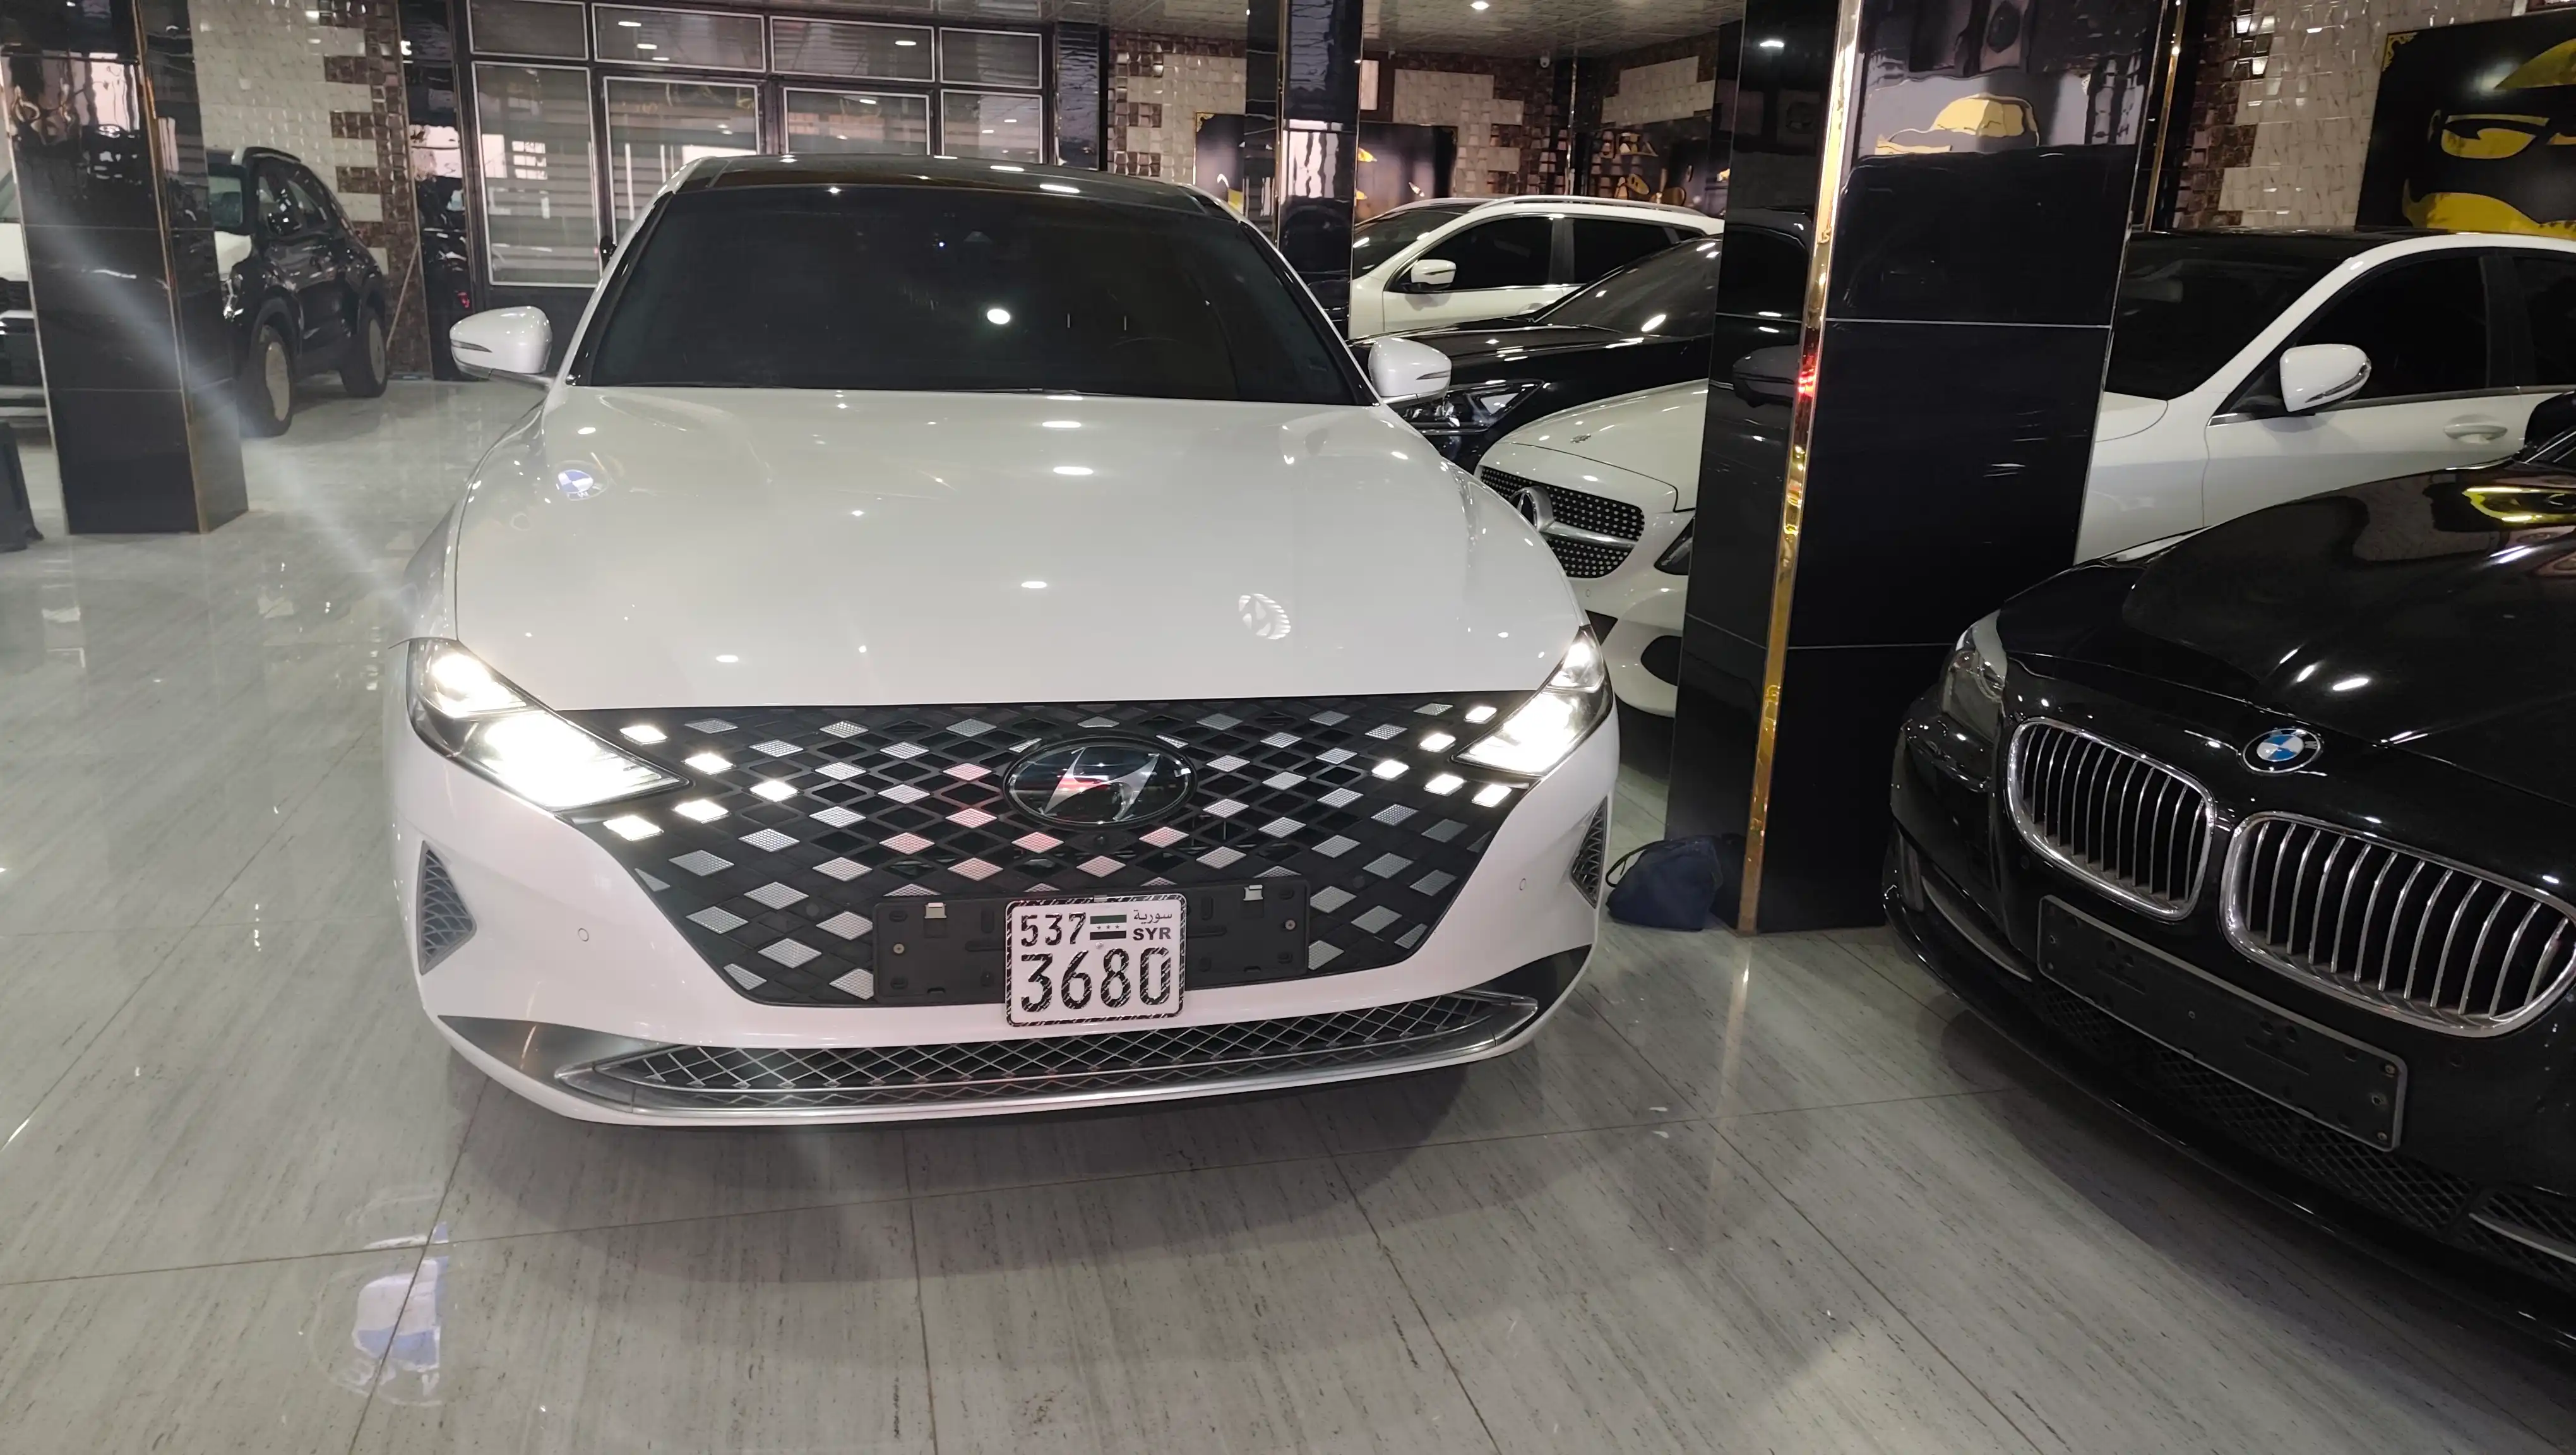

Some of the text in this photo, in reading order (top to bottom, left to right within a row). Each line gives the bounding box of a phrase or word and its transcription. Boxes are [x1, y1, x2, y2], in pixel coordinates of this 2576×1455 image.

[1021, 912, 1086, 947] 537
[1133, 909, 1172, 925] سورية
[1133, 927, 1172, 941] SYR
[1021, 947, 1171, 1012] 3680
